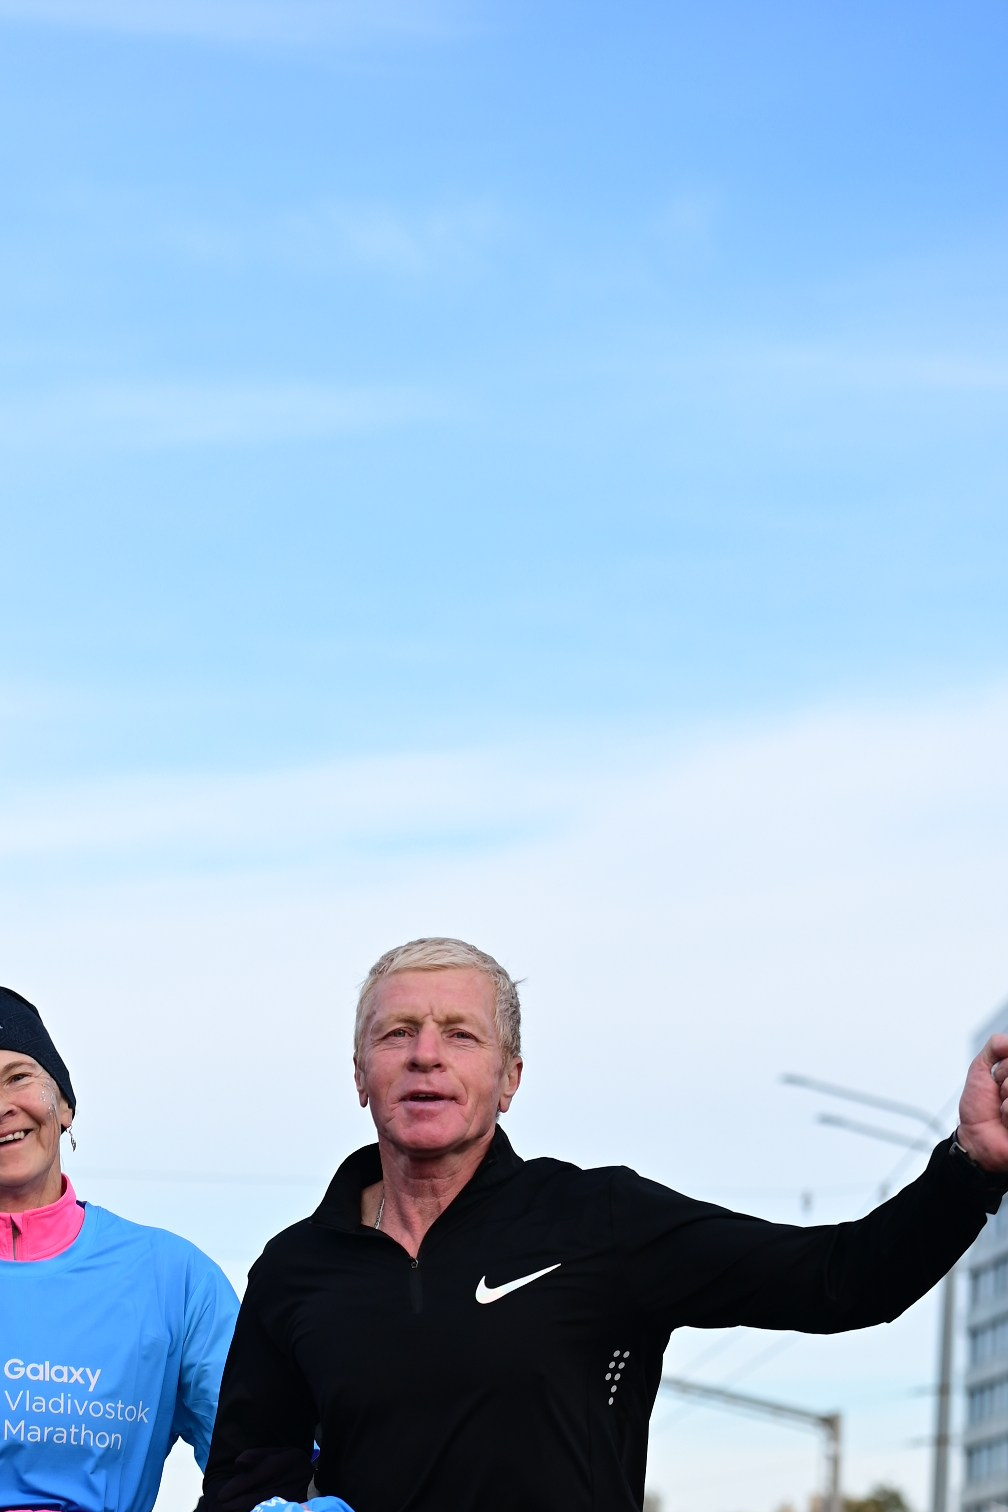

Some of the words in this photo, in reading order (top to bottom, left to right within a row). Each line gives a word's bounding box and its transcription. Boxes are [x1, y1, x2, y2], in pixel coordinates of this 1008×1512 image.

[3, 1358, 102, 1392] Galaxy
[4, 1389, 150, 1424] Vladivostok
[3, 1418, 122, 1450] Marathon
